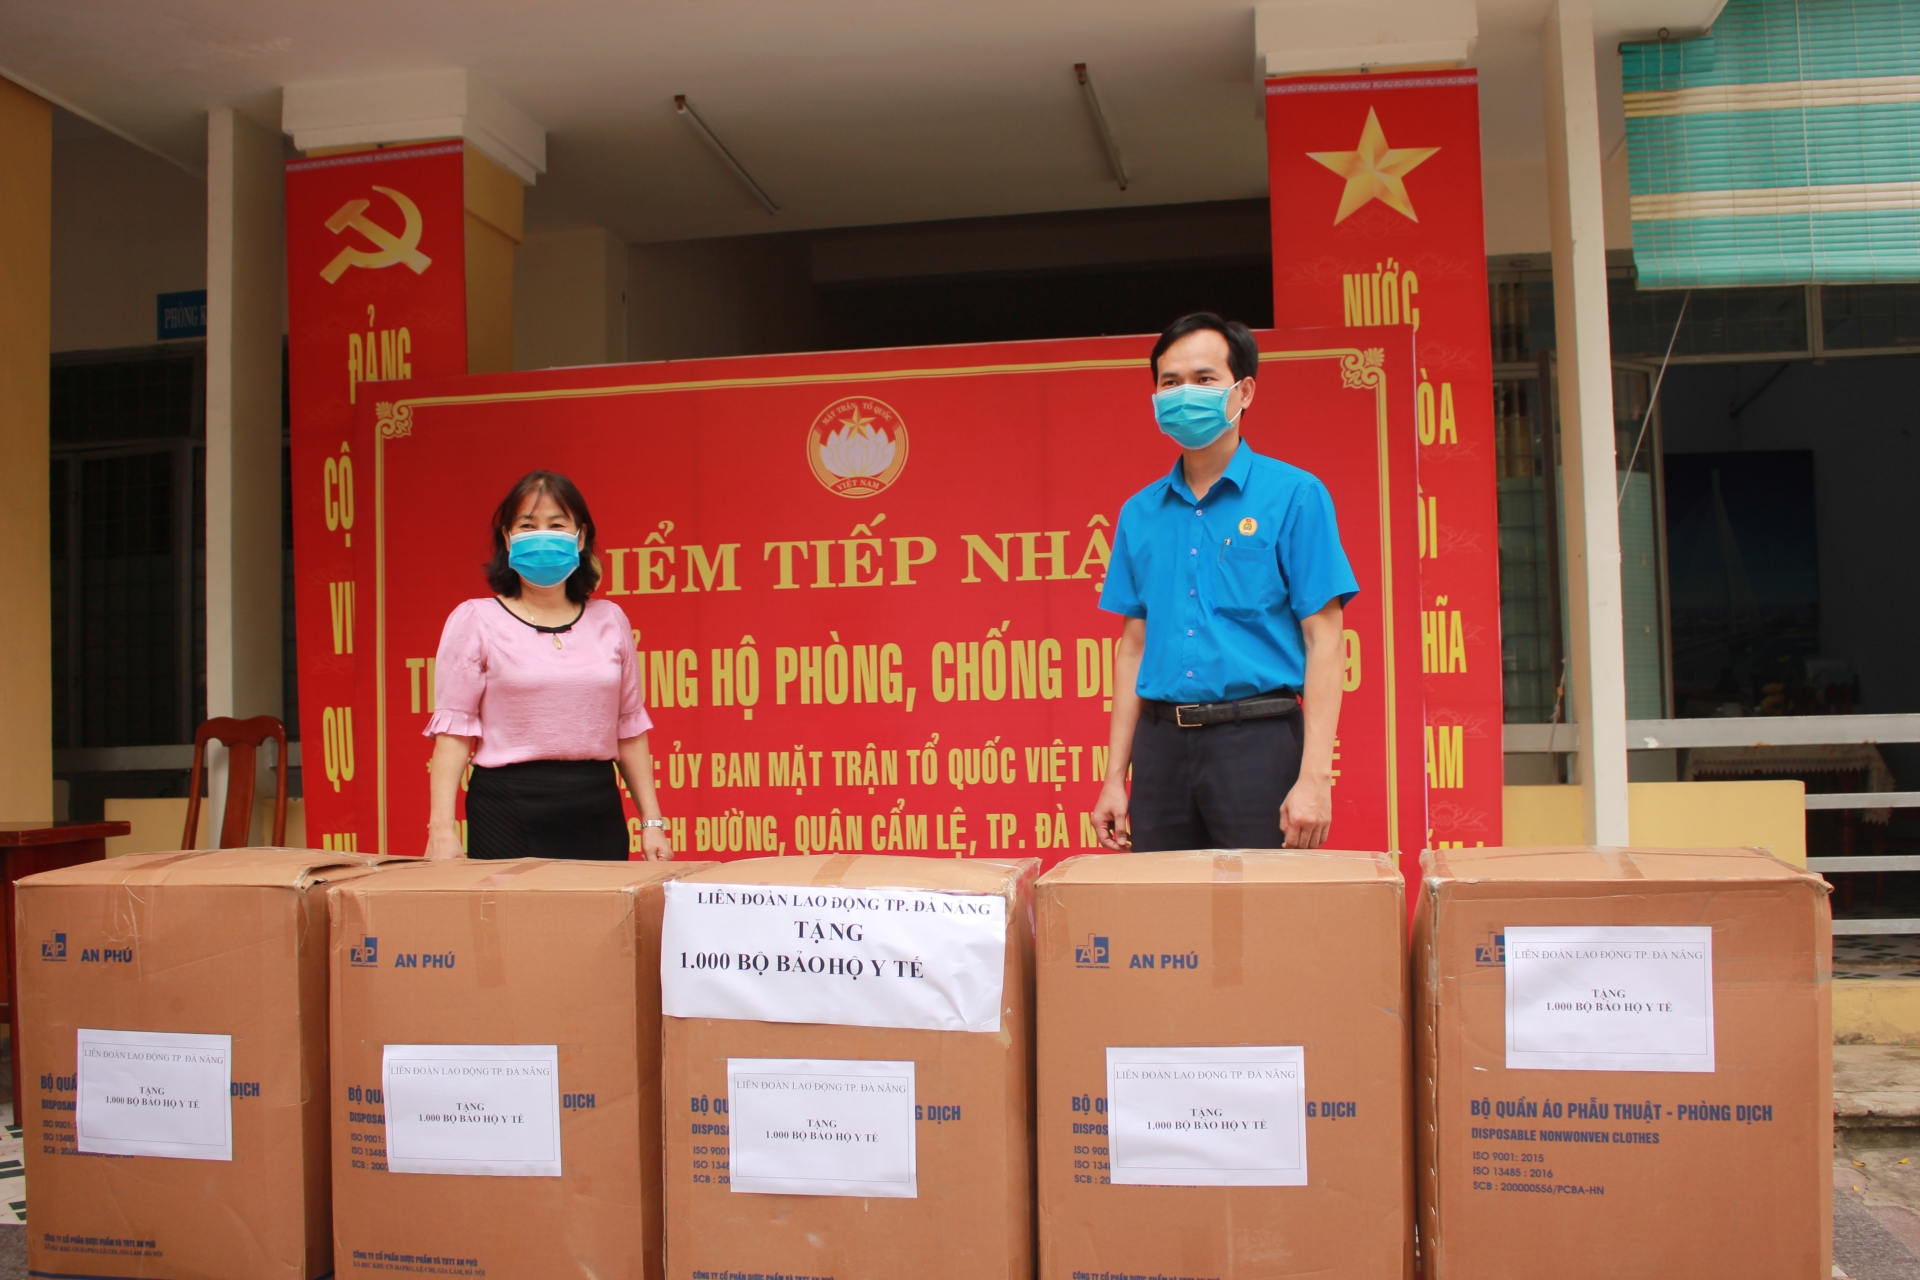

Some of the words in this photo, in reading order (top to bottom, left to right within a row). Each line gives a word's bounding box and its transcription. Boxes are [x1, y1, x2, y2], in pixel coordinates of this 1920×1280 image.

[1343, 257, 1420, 332] NƯỚC
[348, 303, 412, 404] ĐẢNG
[1417, 368, 1458, 446] ÒA
[324, 441, 354, 547] CỘ
[859, 479, 880, 490] NAM
[764, 512, 937, 590] TIẾP
[960, 513, 1112, 593] NHẬ
[329, 581, 354, 654] VI
[1422, 595, 1467, 673] HĨA
[711, 635, 760, 720] HỘ
[775, 630, 917, 712] PHÒNG,
[931, 620, 1062, 702] CHỐNG
[1077, 637, 1122, 712] DỊ
[1342, 629, 1361, 692] 9
[322, 707, 354, 792] QU
[1425, 726, 1463, 788] AM
[669, 740, 702, 789] ỦY
[711, 751, 761, 788] BAN
[769, 745, 822, 795] MẶT
[832, 742, 898, 795] TRẬN
[907, 732, 940, 786] TỔ
[948, 735, 1016, 790] QUỐC
[1026, 738, 1083, 792] VIỆT
[695, 807, 786, 856] ĐƯỜNG,
[795, 808, 863, 855] QUẬN
[871, 798, 934, 852] CẨM
[937, 806, 977, 858] LỆ,
[987, 813, 1024, 850] TP.
[1035, 803, 1070, 850] ĐÀ
[698, 889, 736, 905] LIÊN
[741, 890, 787, 907] ĐOÀN
[793, 895, 827, 907] LAO
[831, 895, 879, 912] ĐỘNG
[885, 898, 909, 912] TP.
[913, 897, 937, 913] ĐÀ
[794, 918, 864, 944] TẶNG
[81, 949, 100, 963] AN
[104, 947, 133, 963] PHÚ
[395, 954, 418, 968] AN
[422, 951, 455, 969] PHÚ
[1129, 954, 1154, 969] AN
[1161, 951, 1199, 970] PHÚ
[1515, 948, 1539, 959] LIÊN
[1542, 948, 1573, 959] ĐOÀN
[1575, 950, 1598, 959] LAO
[1600, 949, 1631, 961] ĐỘNG
[1634, 950, 1649, 959] TP.
[1652, 948, 1668, 959] ĐÀ
[680, 952, 730, 970] 1.000
[737, 951, 769, 976] BỘ
[776, 950, 825, 974] BẢO
[829, 956, 864, 981] HỘ
[870, 959, 887, 977] Y
[893, 955, 924, 979] TẾ
[1591, 987, 1626, 1000] TẶNG
[1546, 1002, 1572, 1011] 1.000
[1576, 1001, 1592, 1014] BỘ
[1624, 1001, 1642, 1014] HỘ
[1645, 1002, 1654, 1012] Y
[40, 1074, 54, 1092] BỘ
[1116, 1068, 1139, 1079] LIÊN
[1142, 1069, 1171, 1080] ĐOÀN
[1174, 1070, 1195, 1080] LAO
[1198, 1070, 1227, 1081] ĐỘNG
[1230, 1070, 1245, 1080] TP.
[1247, 1068, 1263, 1079] ĐÀ
[231, 1081, 260, 1100] DỊCH
[348, 1085, 362, 1105] BỘ
[736, 1078, 759, 1089] LIÊN
[761, 1079, 789, 1090] ĐOÀN
[792, 1081, 812, 1091] LAO
[814, 1081, 843, 1092] ĐỘNG
[845, 1083, 859, 1092] TP.
[861, 1082, 875, 1093] ĐÀ
[41, 1099, 77, 1112] DISPOSAB
[563, 1093, 596, 1112] DỊCH
[690, 1095, 709, 1116] BỘ
[1072, 1095, 1091, 1115] BỘ
[1321, 1102, 1356, 1121] DỊCH
[1471, 1097, 1491, 1120] BỘ
[1496, 1096, 1537, 1118] QUẦN
[1542, 1098, 1563, 1119] ÁO
[1568, 1097, 1609, 1120] PHẪU
[1613, 1101, 1661, 1124] THUẬT
[1678, 1101, 1731, 1121] PHÒNG
[1736, 1104, 1773, 1125] DỊCH
[927, 1105, 961, 1124] DỊCH
[1190, 1107, 1222, 1119] TẶNG
[806, 1118, 837, 1130] TẶNG
[1147, 1121, 1172, 1130] 1.000
[1175, 1119, 1191, 1132] BỘ
[1221, 1119, 1239, 1132] HỘ
[1241, 1121, 1249, 1130] Y
[351, 1133, 362, 1142] ISO
[364, 1134, 384, 1143] 9001:
[766, 1130, 789, 1139] 1.000
[792, 1129, 807, 1142] BỘ
[836, 1131, 852, 1143] HỘ
[854, 1133, 862, 1141] Y
[1471, 1128, 1536, 1142] DISPOSABLE
[1539, 1130, 1609, 1143] NONWONVEN
[1612, 1131, 1659, 1145] CLOTHES
[351, 1147, 362, 1156] ISO
[1473, 1151, 1490, 1161] ISO
[1492, 1152, 1519, 1162] 9001:
[1521, 1153, 1544, 1163] 2015
[351, 1160, 366, 1169] SCB
[1473, 1166, 1490, 1176] ISO
[1493, 1167, 1521, 1177] 13485
[1529, 1168, 1554, 1178] 2016
[1473, 1181, 1493, 1191] SCB
[1500, 1183, 1605, 1195] 200000556/PCBA-HN
[456, 1258, 465, 1266] AN
